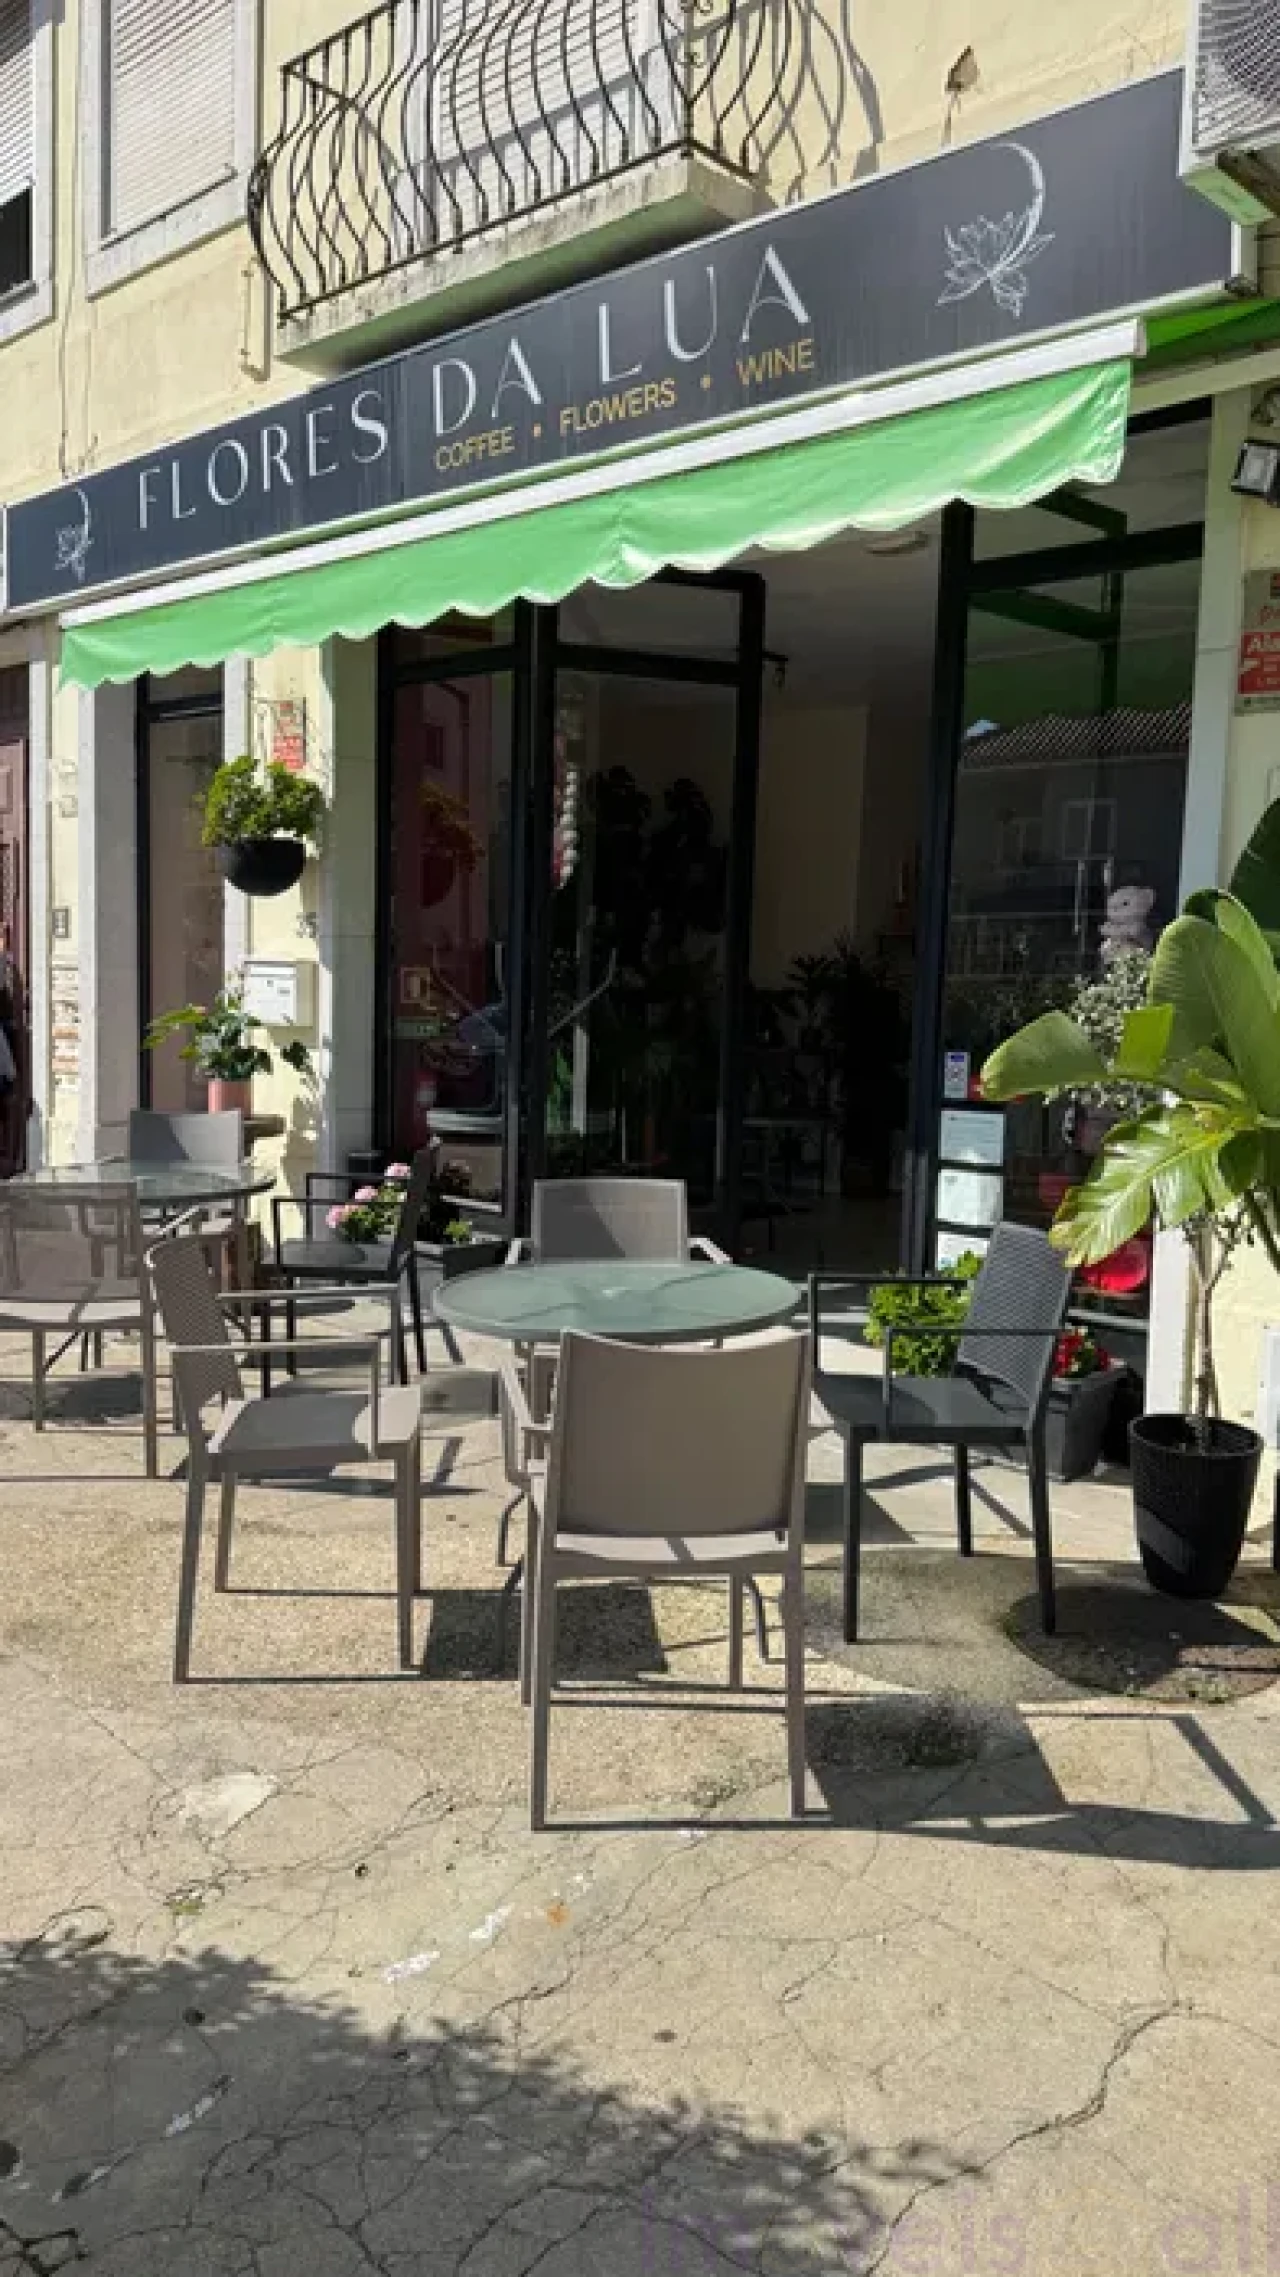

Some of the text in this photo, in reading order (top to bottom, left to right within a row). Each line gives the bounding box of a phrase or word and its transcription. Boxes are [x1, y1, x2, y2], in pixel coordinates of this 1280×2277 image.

[138, 244, 811, 528] FLORES DA LUA
[435, 338, 816, 472] COFFEE FLOWERS WINE
